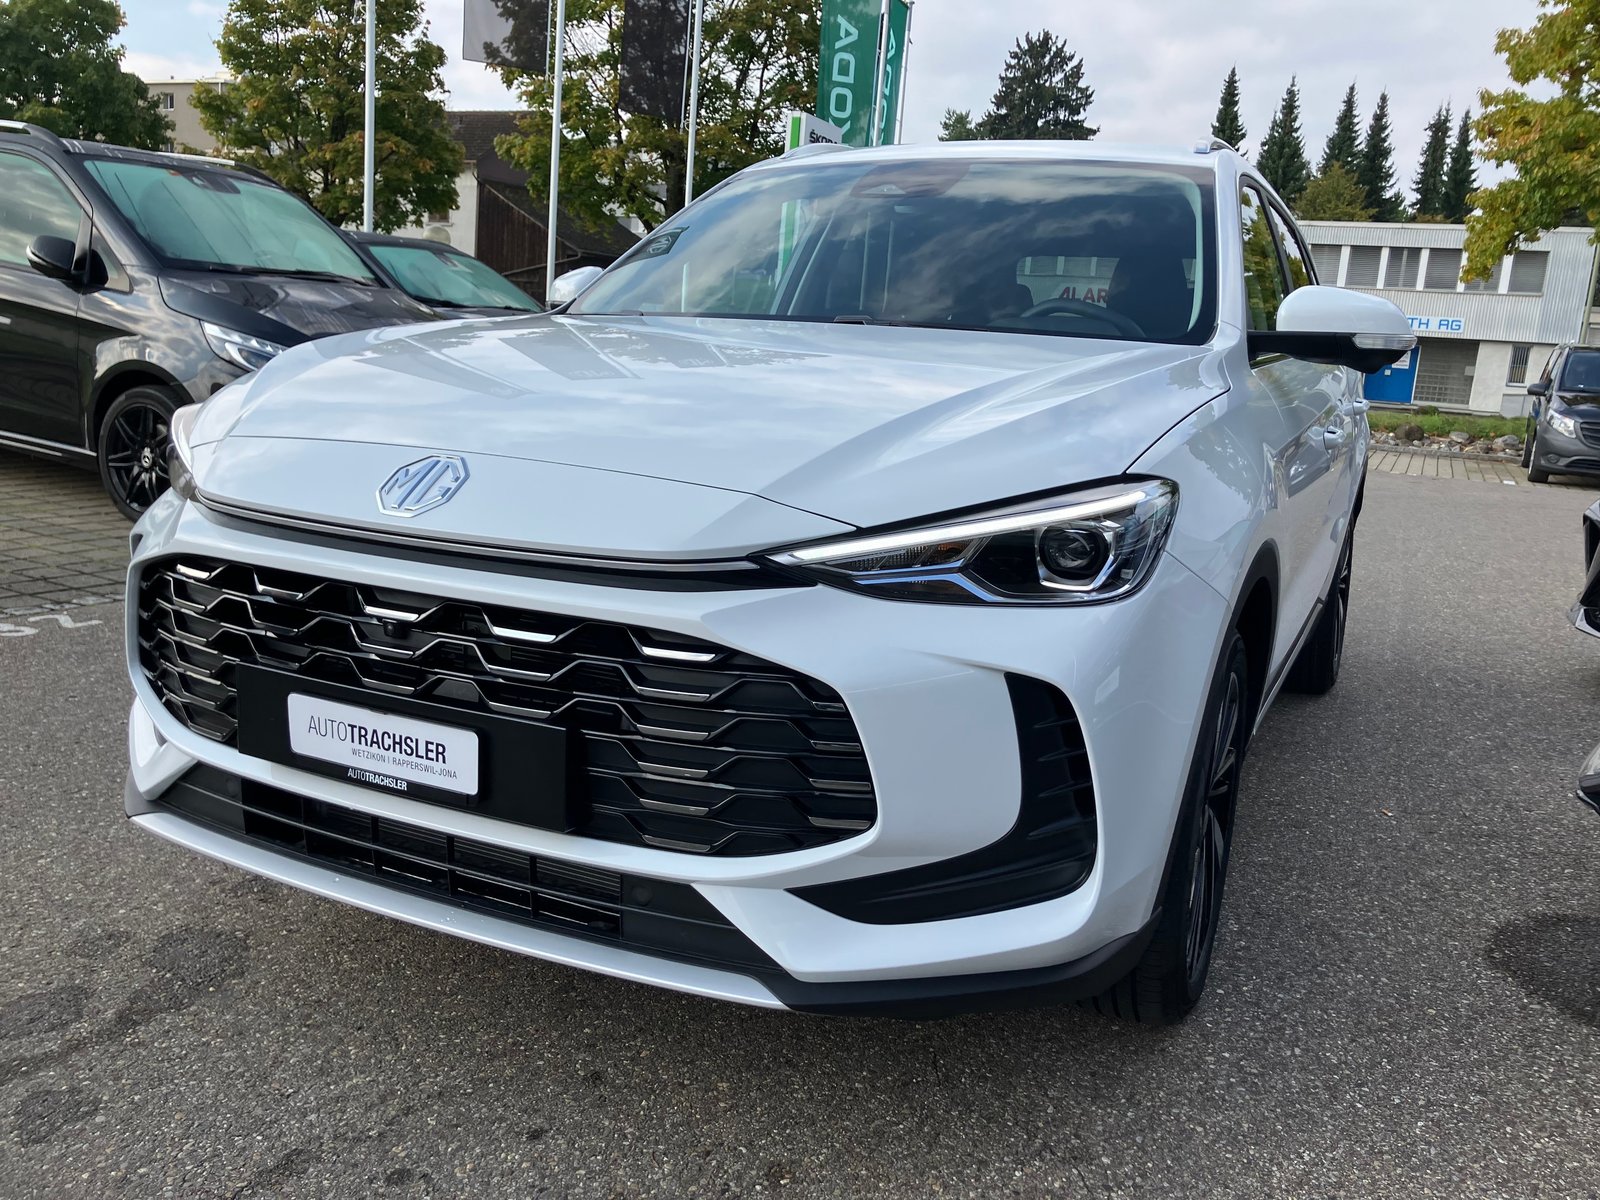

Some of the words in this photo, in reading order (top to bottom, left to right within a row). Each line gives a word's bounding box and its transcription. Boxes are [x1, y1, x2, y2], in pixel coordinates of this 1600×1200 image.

[809, 129, 838, 144] ŠKO
[1438, 318, 1462, 331] AG
[380, 457, 466, 514] MG
[308, 715, 447, 764] AUTOTRACHSLER
[351, 747, 386, 763] WETZIKON
[392, 758, 458, 780] RAPPERSWIL-JONA
[347, 768, 408, 791] AUTOTRACHSLER
